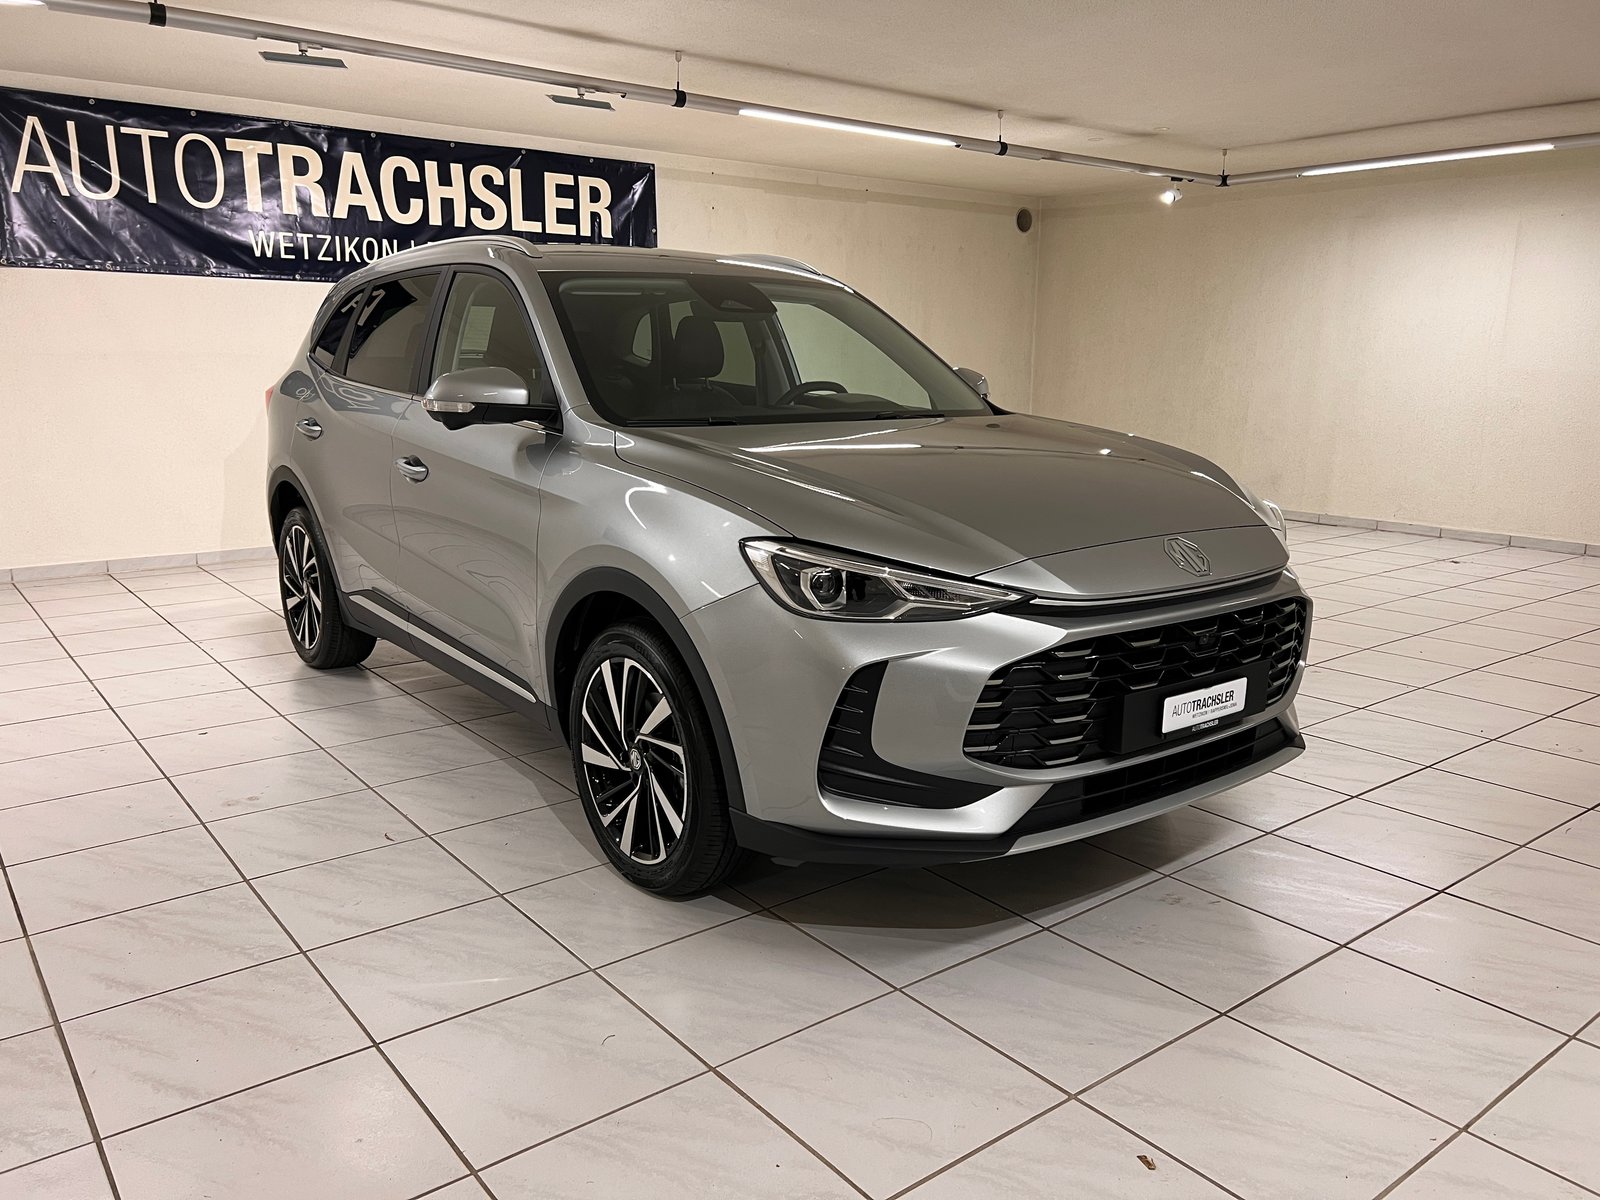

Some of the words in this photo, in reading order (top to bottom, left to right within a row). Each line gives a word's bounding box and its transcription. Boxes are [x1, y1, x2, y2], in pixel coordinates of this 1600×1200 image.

[11, 114, 614, 239] AUTOTRACHSLER
[248, 229, 398, 264] WETZIKON
[1171, 690, 1235, 718] AUTOTRACHSLER
